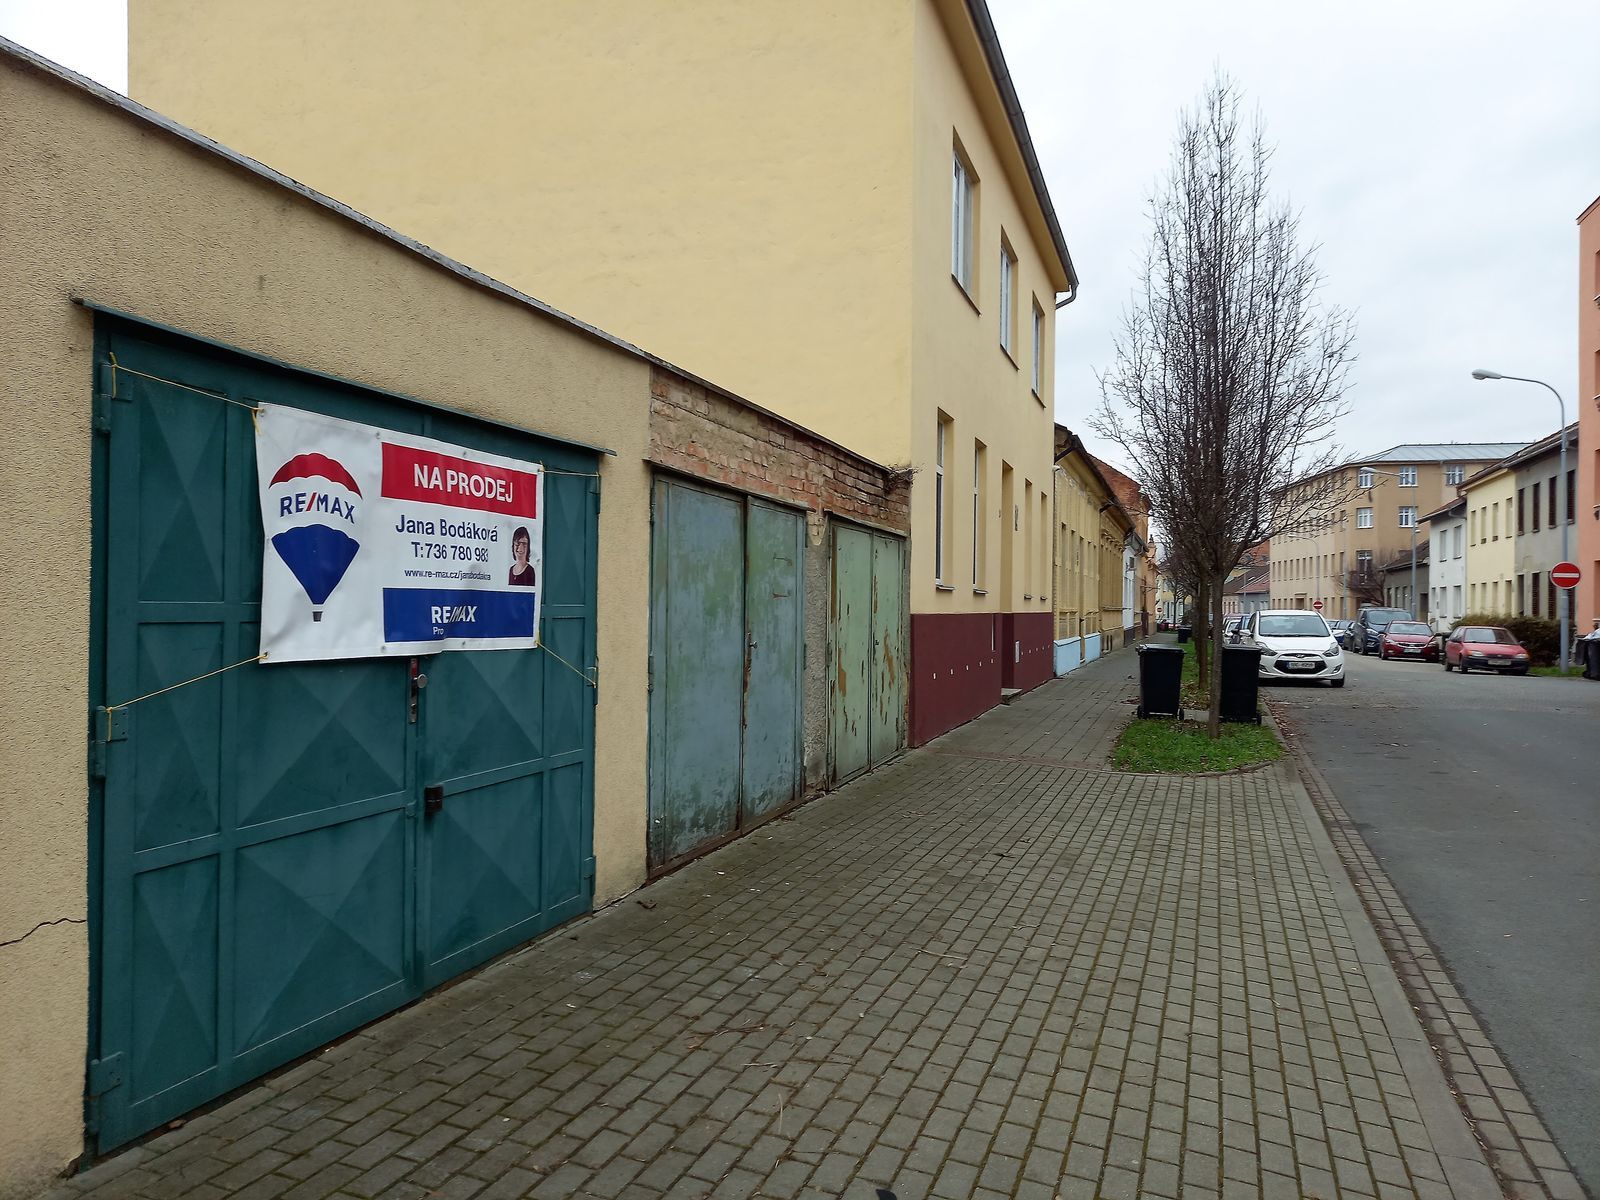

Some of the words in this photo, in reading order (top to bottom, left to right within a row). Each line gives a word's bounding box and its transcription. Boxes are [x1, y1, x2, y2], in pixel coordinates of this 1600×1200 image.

[413, 463, 443, 491] NA
[446, 469, 513, 503] PRODEJ
[280, 492, 354, 524] RE/MAX
[396, 515, 434, 536] Jana
[450, 546, 472, 561] 780
